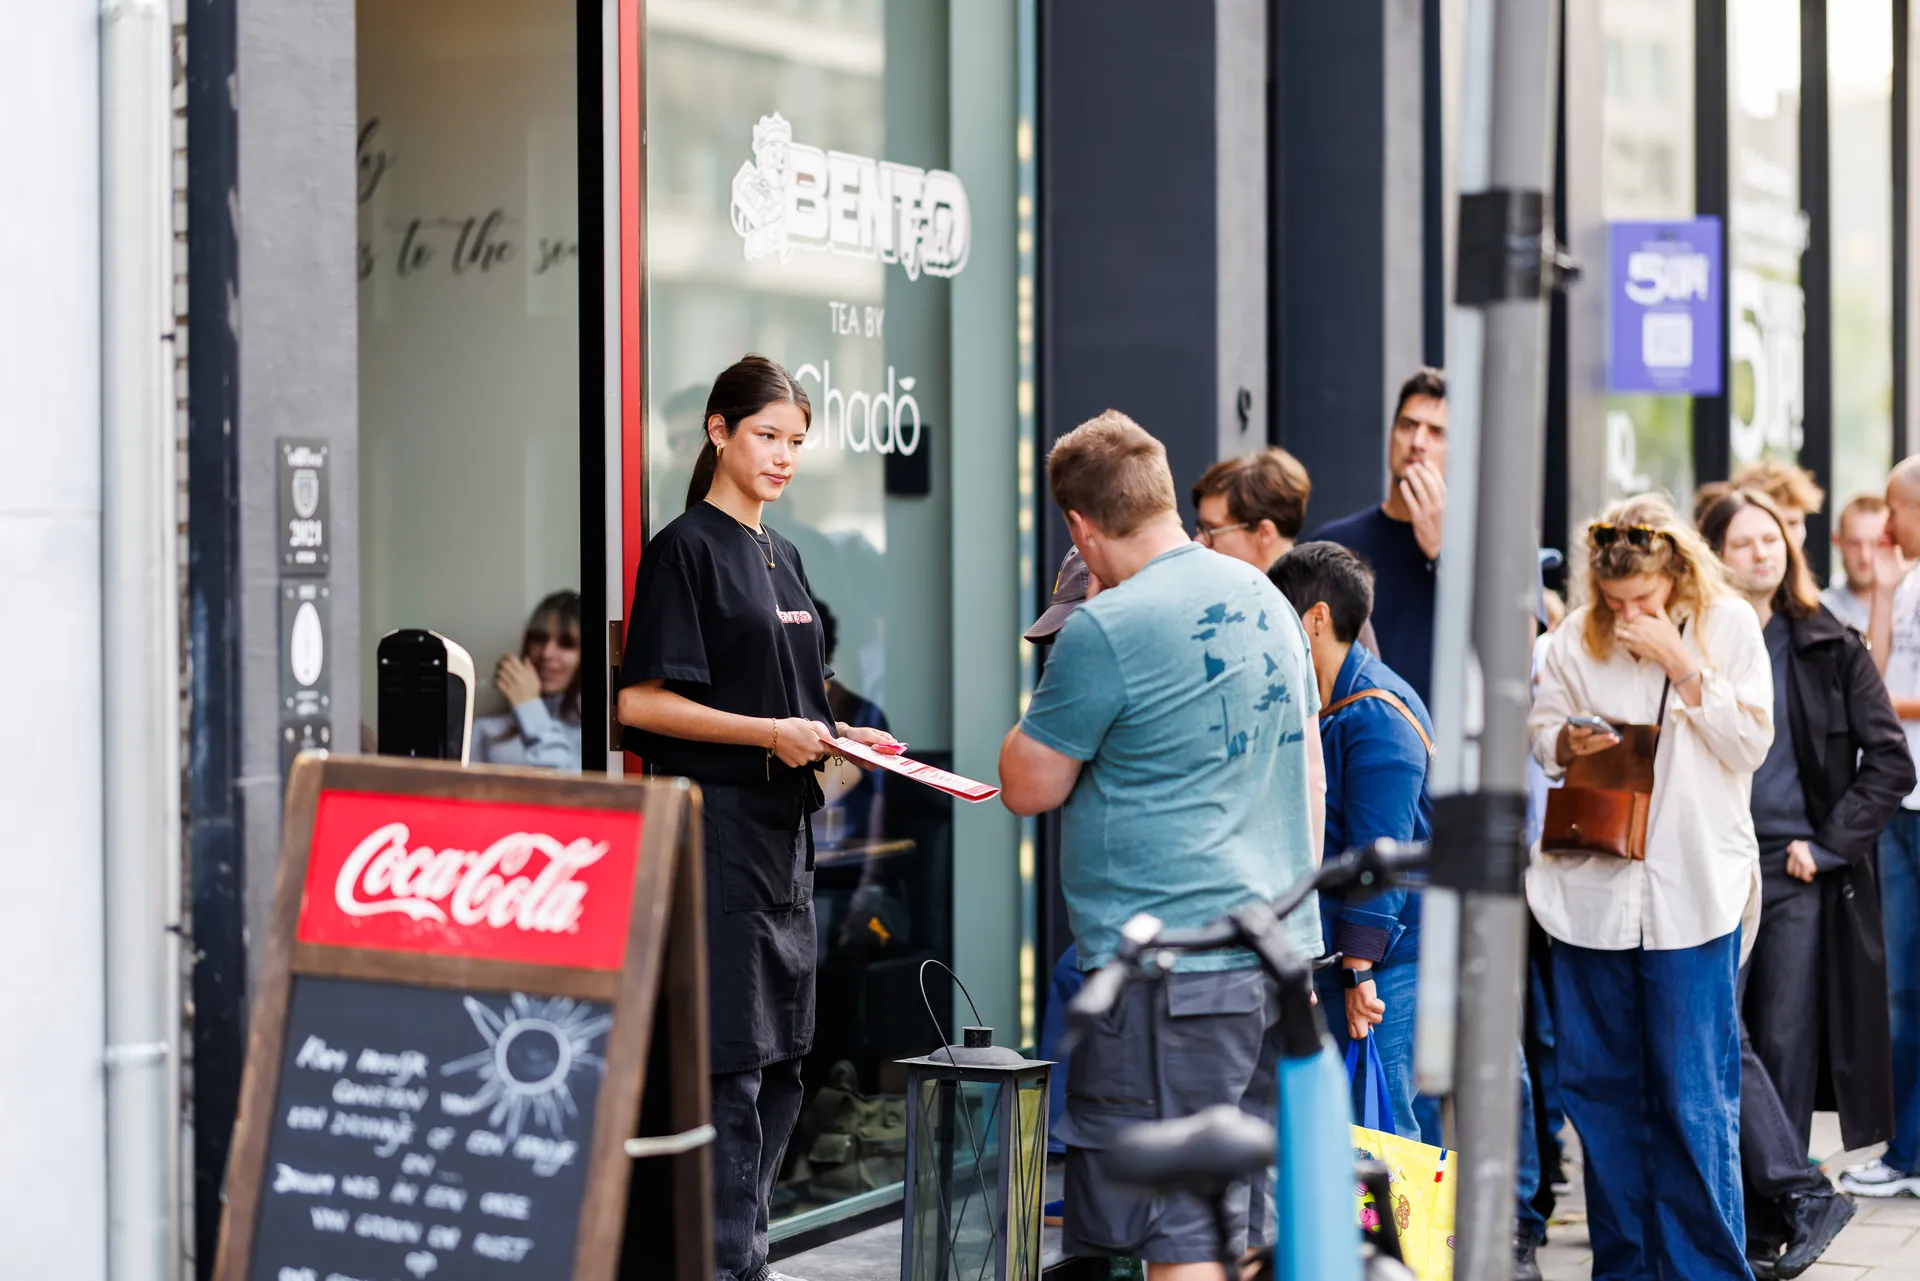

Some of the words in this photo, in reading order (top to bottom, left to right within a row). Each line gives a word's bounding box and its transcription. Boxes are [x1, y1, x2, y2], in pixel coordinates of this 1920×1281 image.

[451, 207, 513, 275] the
[829, 301, 860, 336] TEA
[864, 306, 884, 338] BY
[335, 822, 610, 934] Coca-Cola
